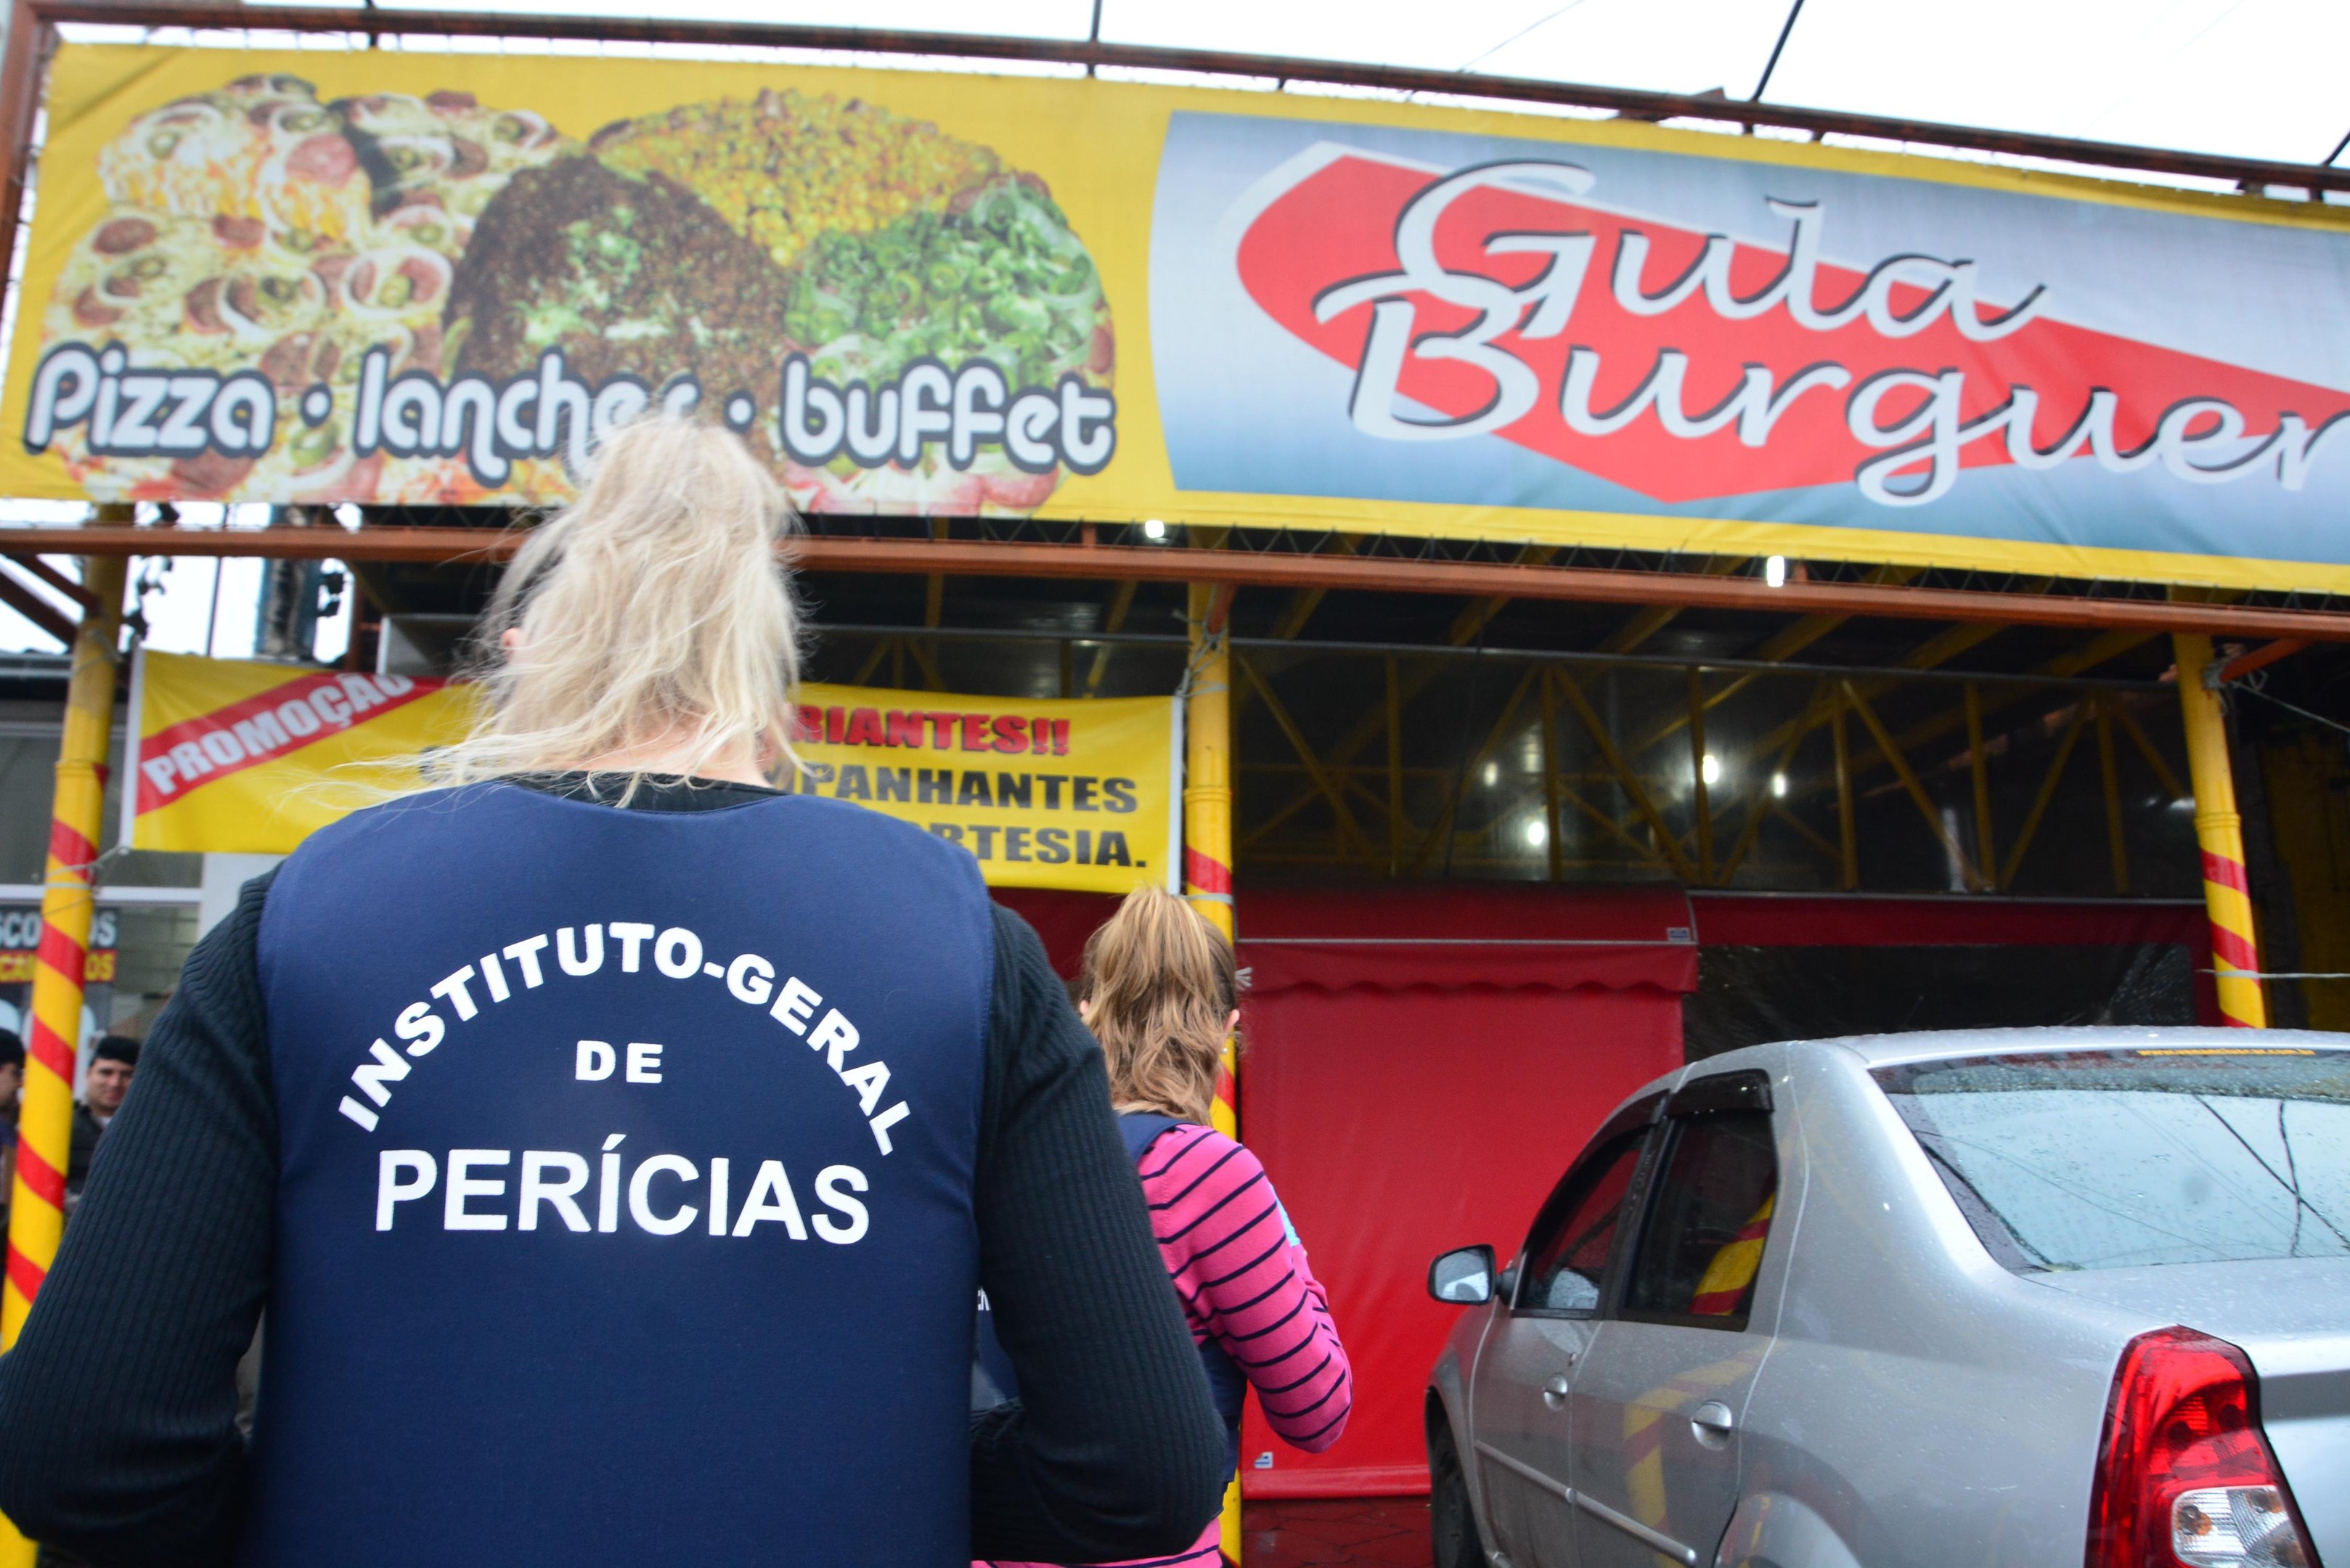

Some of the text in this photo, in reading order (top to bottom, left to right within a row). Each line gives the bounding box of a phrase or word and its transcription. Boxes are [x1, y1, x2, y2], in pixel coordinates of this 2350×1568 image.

[1392, 157, 2049, 343] Gula
[24, 340, 277, 458] Pizza
[779, 351, 1117, 475] buffet
[1311, 269, 2350, 507] Burguer
[142, 674, 415, 795] PROMOÇÃO
[338, 921, 910, 1156] INSTITUTO-GERAL
[575, 1040, 664, 1084] DE
[375, 1133, 870, 1245] PERÍCIAS
